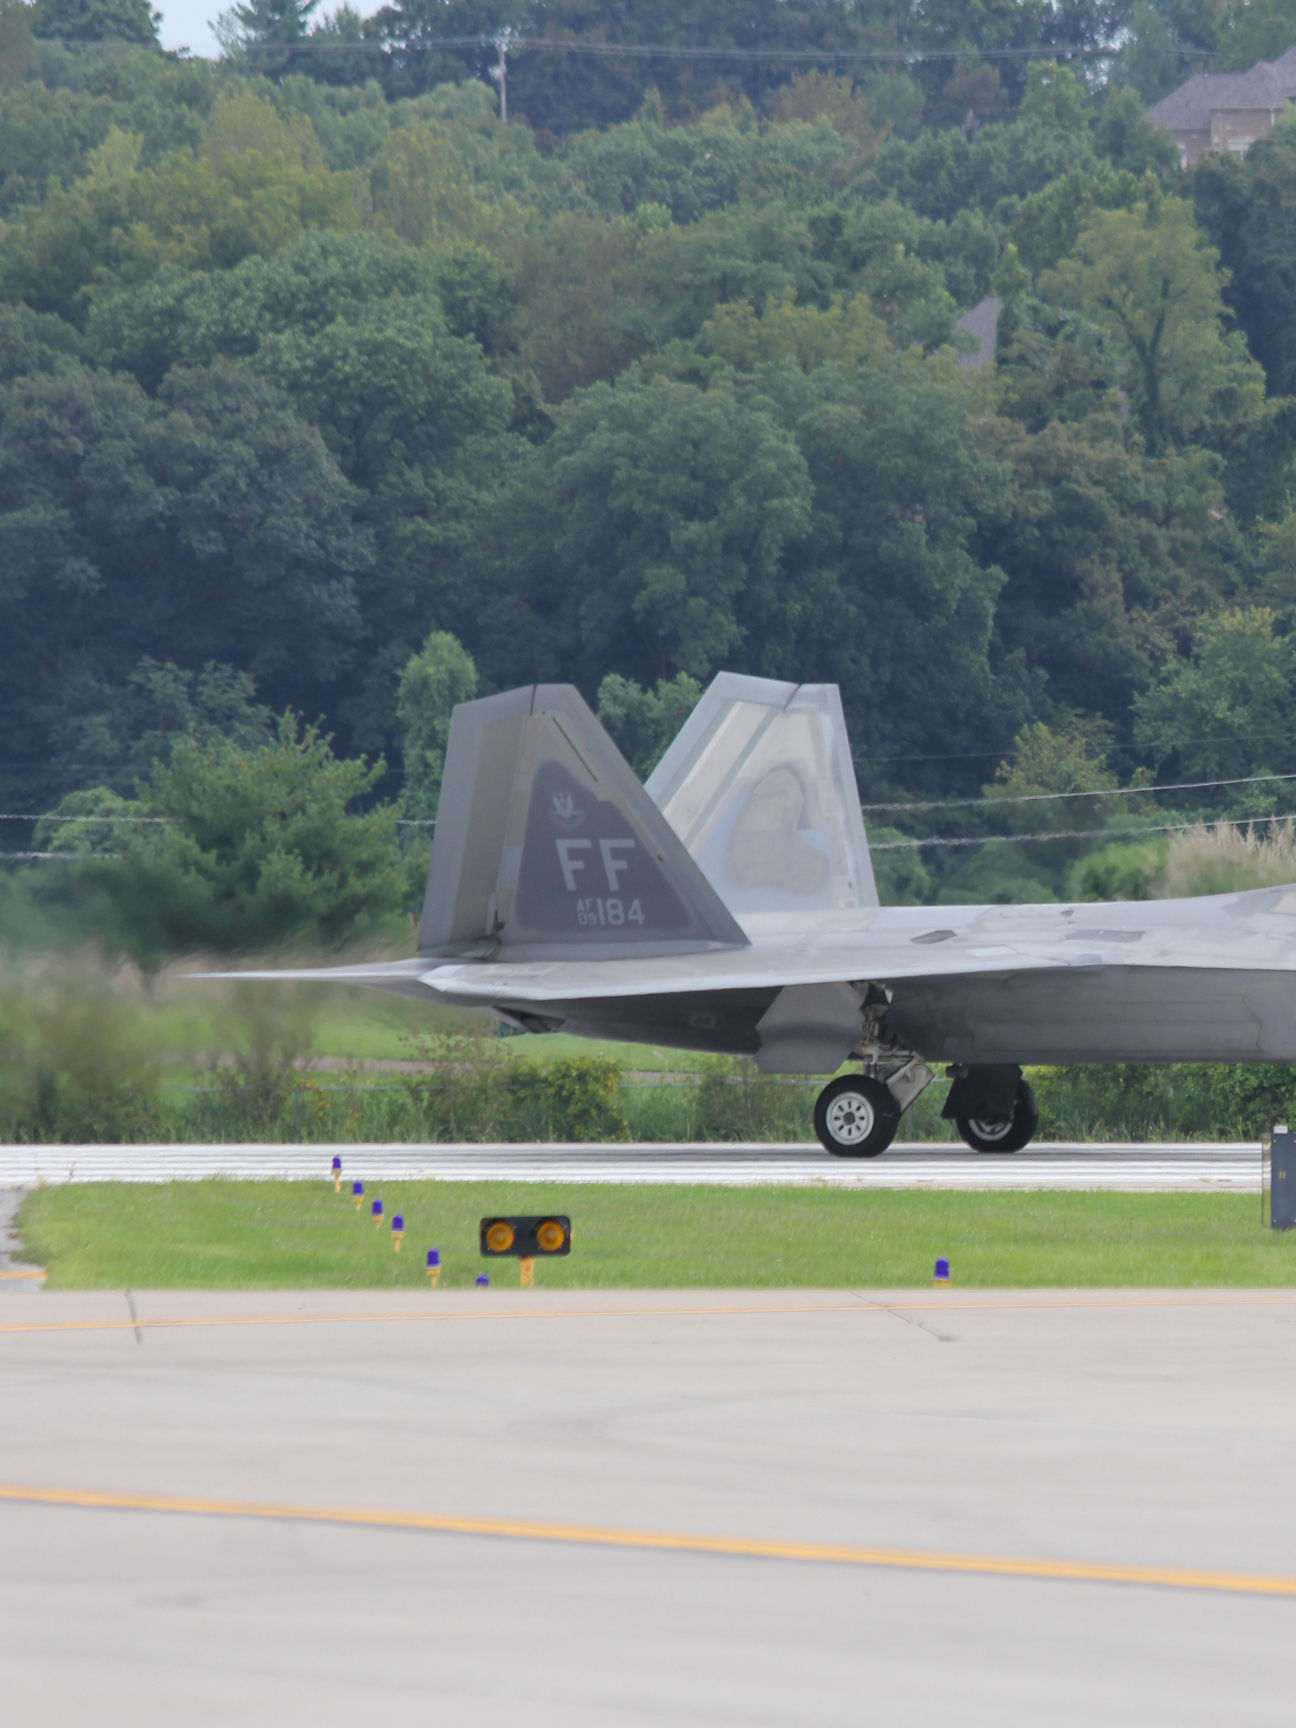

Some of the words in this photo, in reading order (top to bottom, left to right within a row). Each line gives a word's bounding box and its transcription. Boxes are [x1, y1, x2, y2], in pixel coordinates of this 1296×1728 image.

[554, 838, 635, 891] FF
[577, 898, 593, 912] AF
[596, 898, 646, 926] 184
[578, 912, 596, 926] 09
